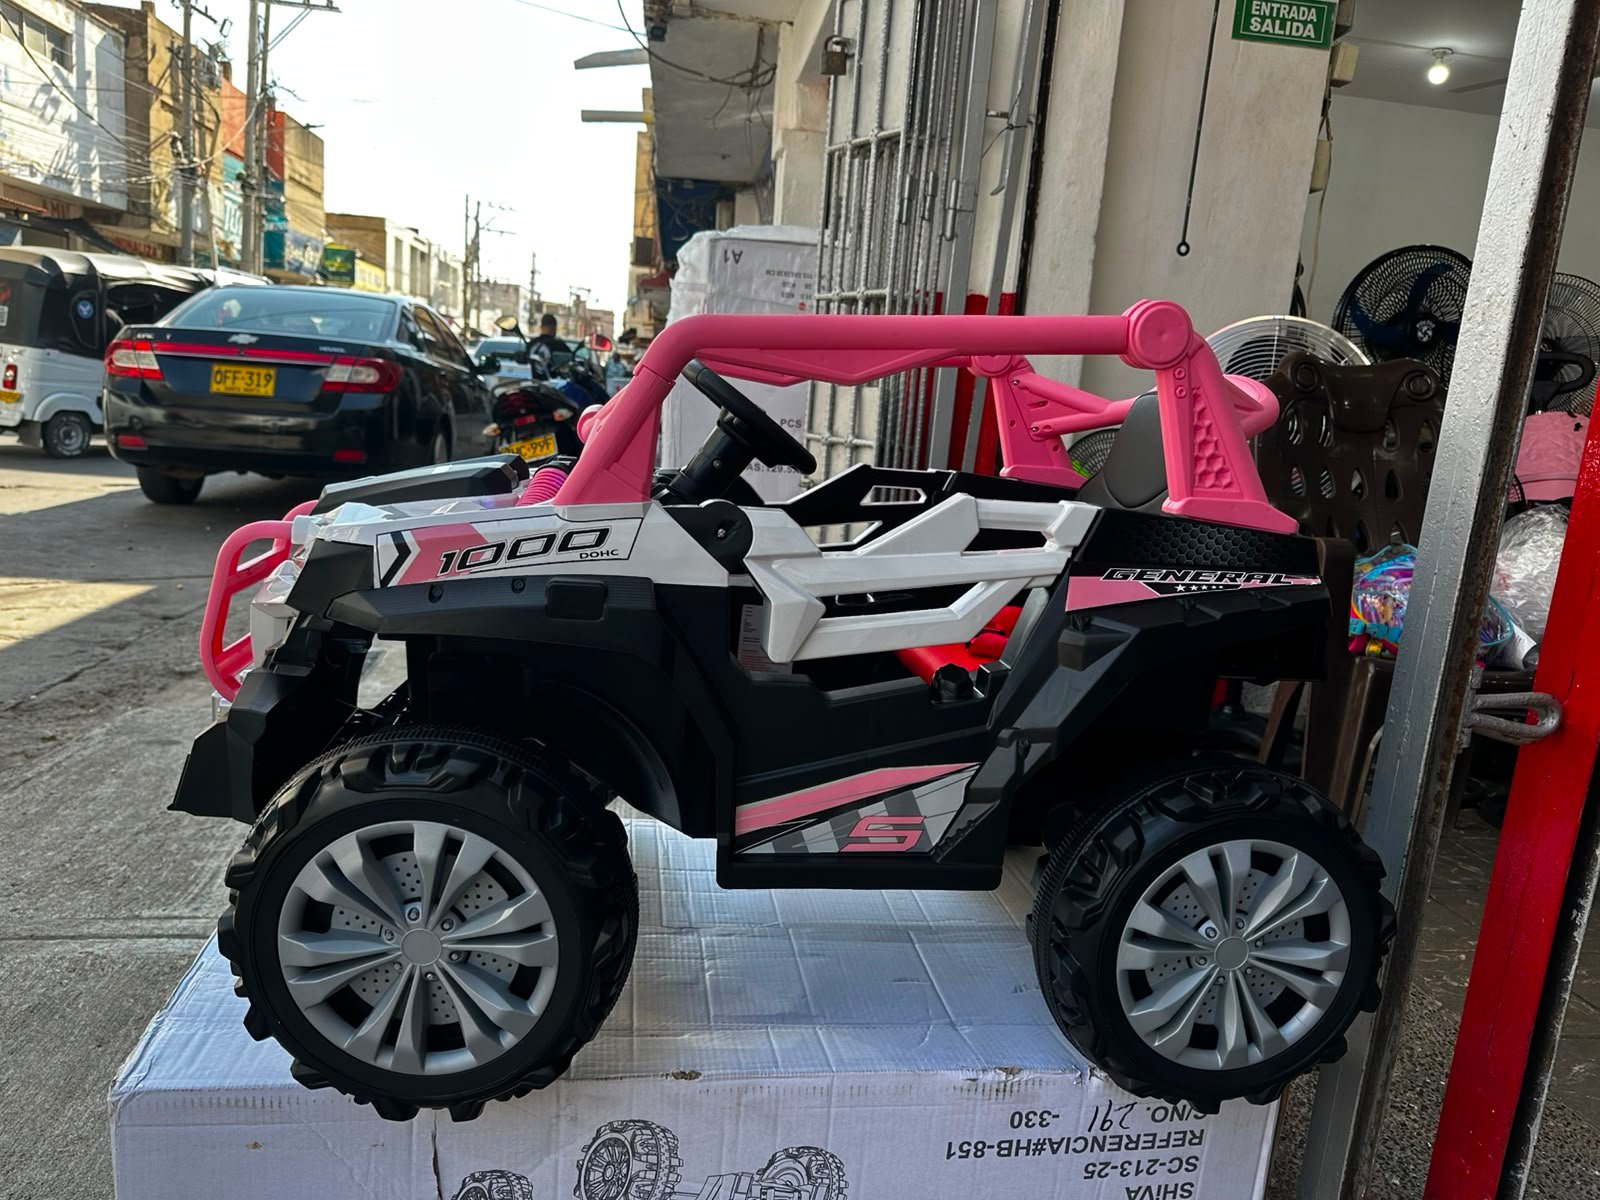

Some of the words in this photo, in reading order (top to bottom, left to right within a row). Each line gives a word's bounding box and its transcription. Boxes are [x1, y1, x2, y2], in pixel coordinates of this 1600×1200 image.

[1251, 0, 1317, 22] ENTRADA
[1249, 16, 1315, 39] SALIDA
[723, 249, 743, 265] A1
[780, 418, 802, 429] PCS
[436, 525, 613, 577] 1000
[579, 547, 619, 560] DOHC
[1100, 567, 1294, 585] GENERAL
[839, 815, 927, 853] S
[1009, 1109, 1060, 1129] -330
[1088, 1099, 1139, 1133] 291
[946, 1128, 1205, 1160] REFERENCIA#HB-851
[1083, 1155, 1200, 1180] SC-213-25
